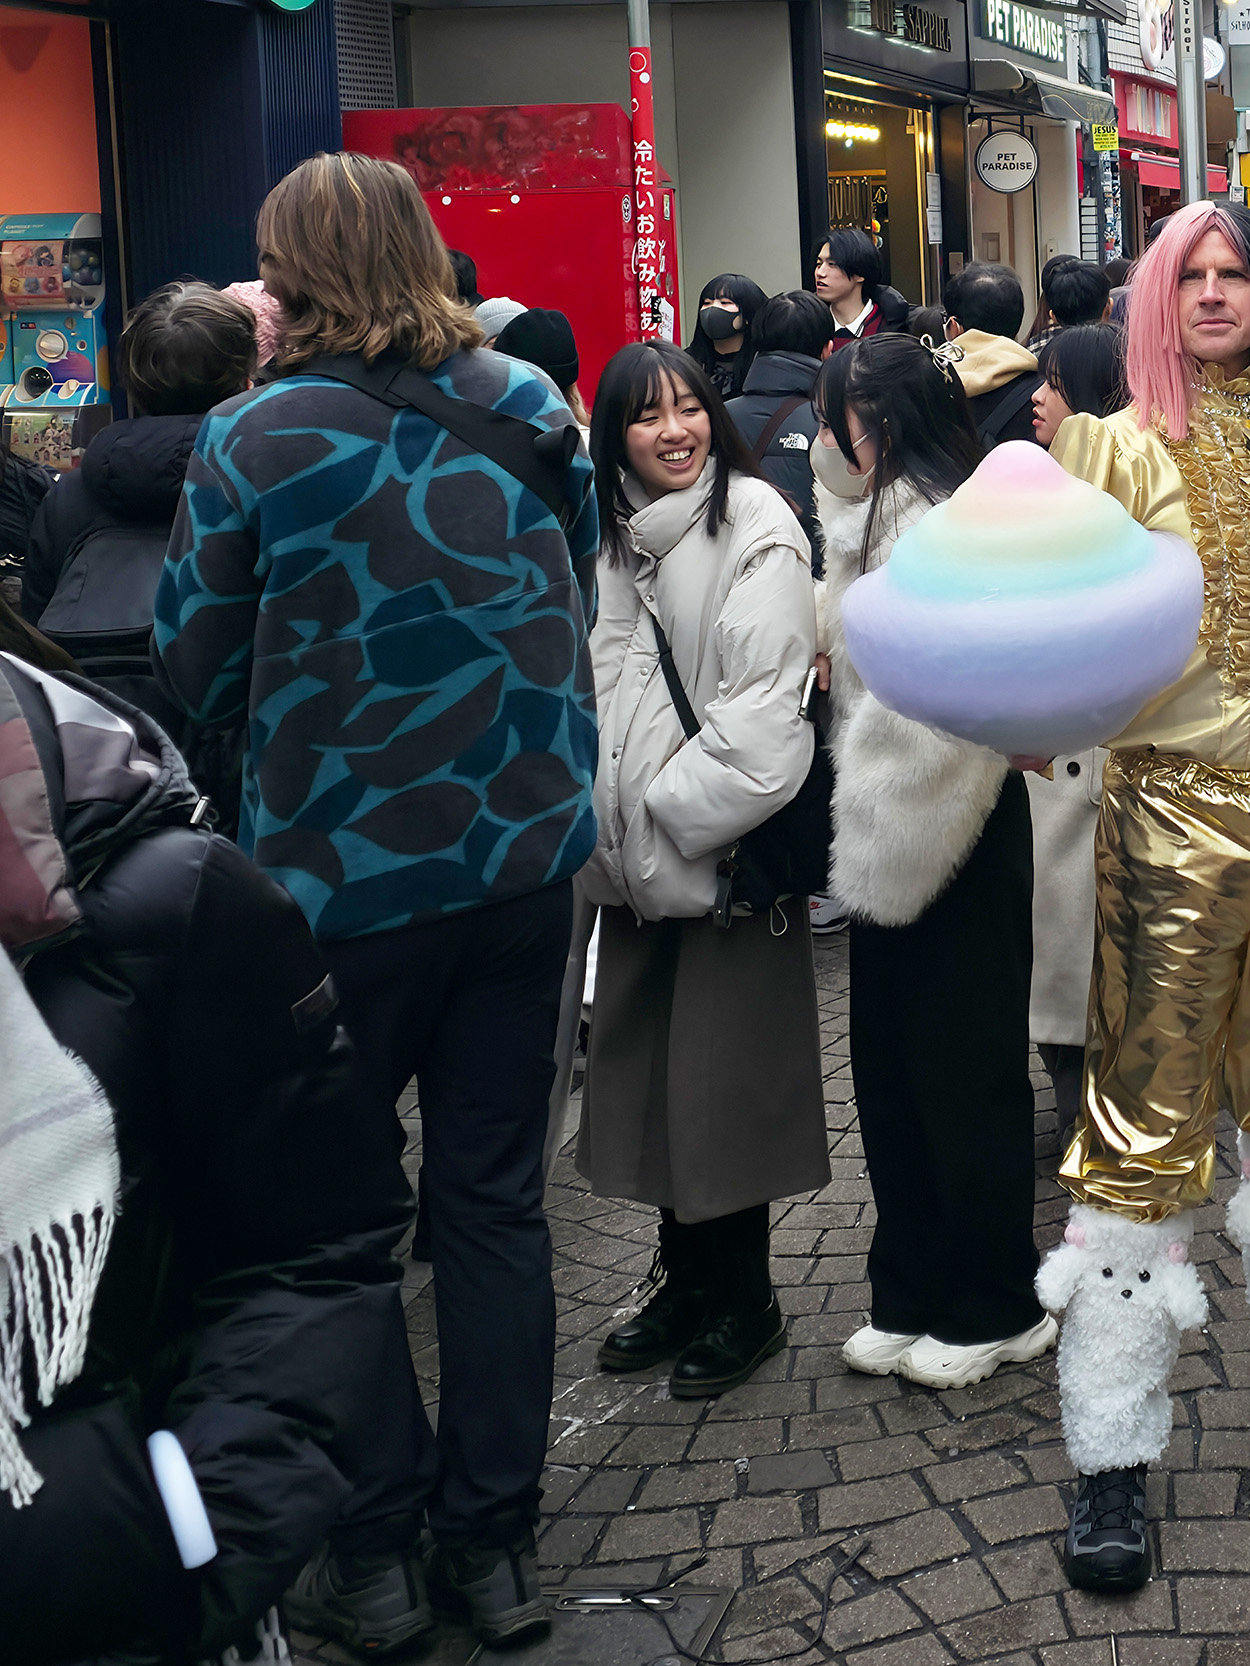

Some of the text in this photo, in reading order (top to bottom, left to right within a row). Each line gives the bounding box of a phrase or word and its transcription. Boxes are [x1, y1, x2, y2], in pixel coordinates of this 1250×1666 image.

[987, 0, 1064, 62] PET PARADISE
[1094, 125, 1116, 134] JESUS
[997, 153, 1017, 161] PET
[982, 162, 1032, 171] PARADISE
